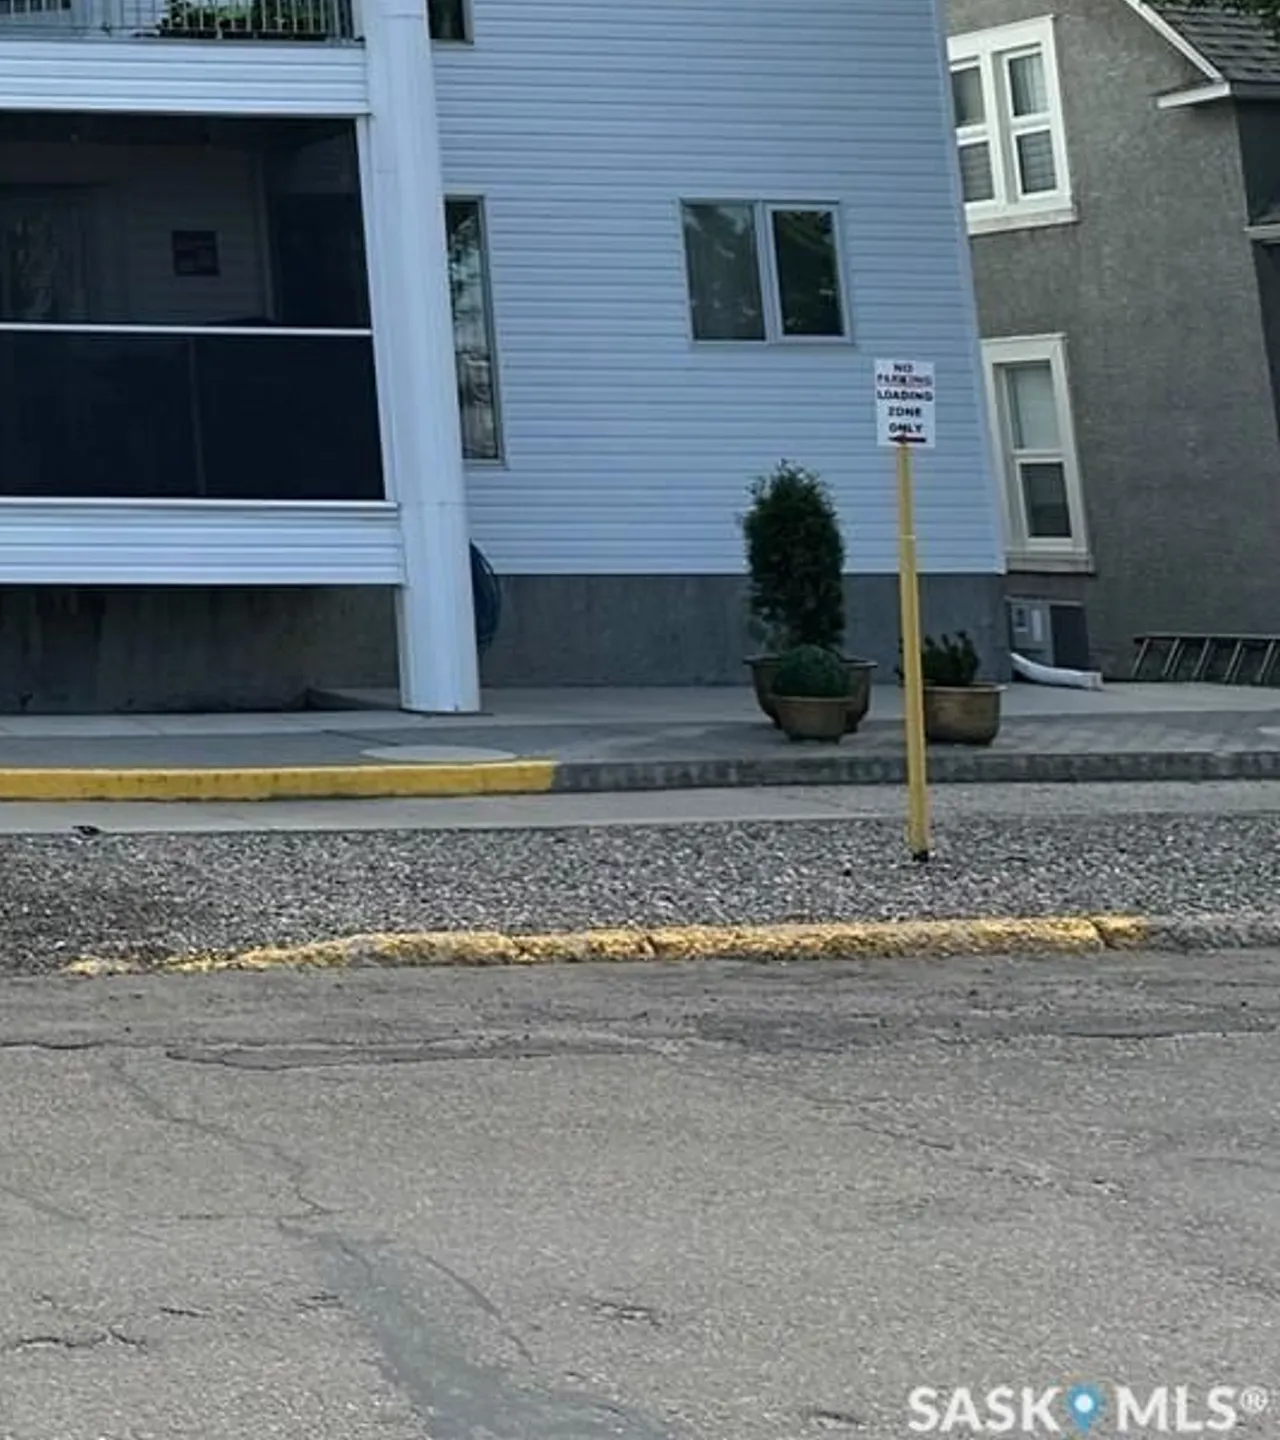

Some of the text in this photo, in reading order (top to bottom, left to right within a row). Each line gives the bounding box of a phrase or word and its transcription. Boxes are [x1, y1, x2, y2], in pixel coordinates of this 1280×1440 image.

[893, 364, 914, 373] NO
[877, 390, 933, 401] LOADING
[888, 406, 922, 417] ZONE
[888, 422, 923, 433] ONLY
